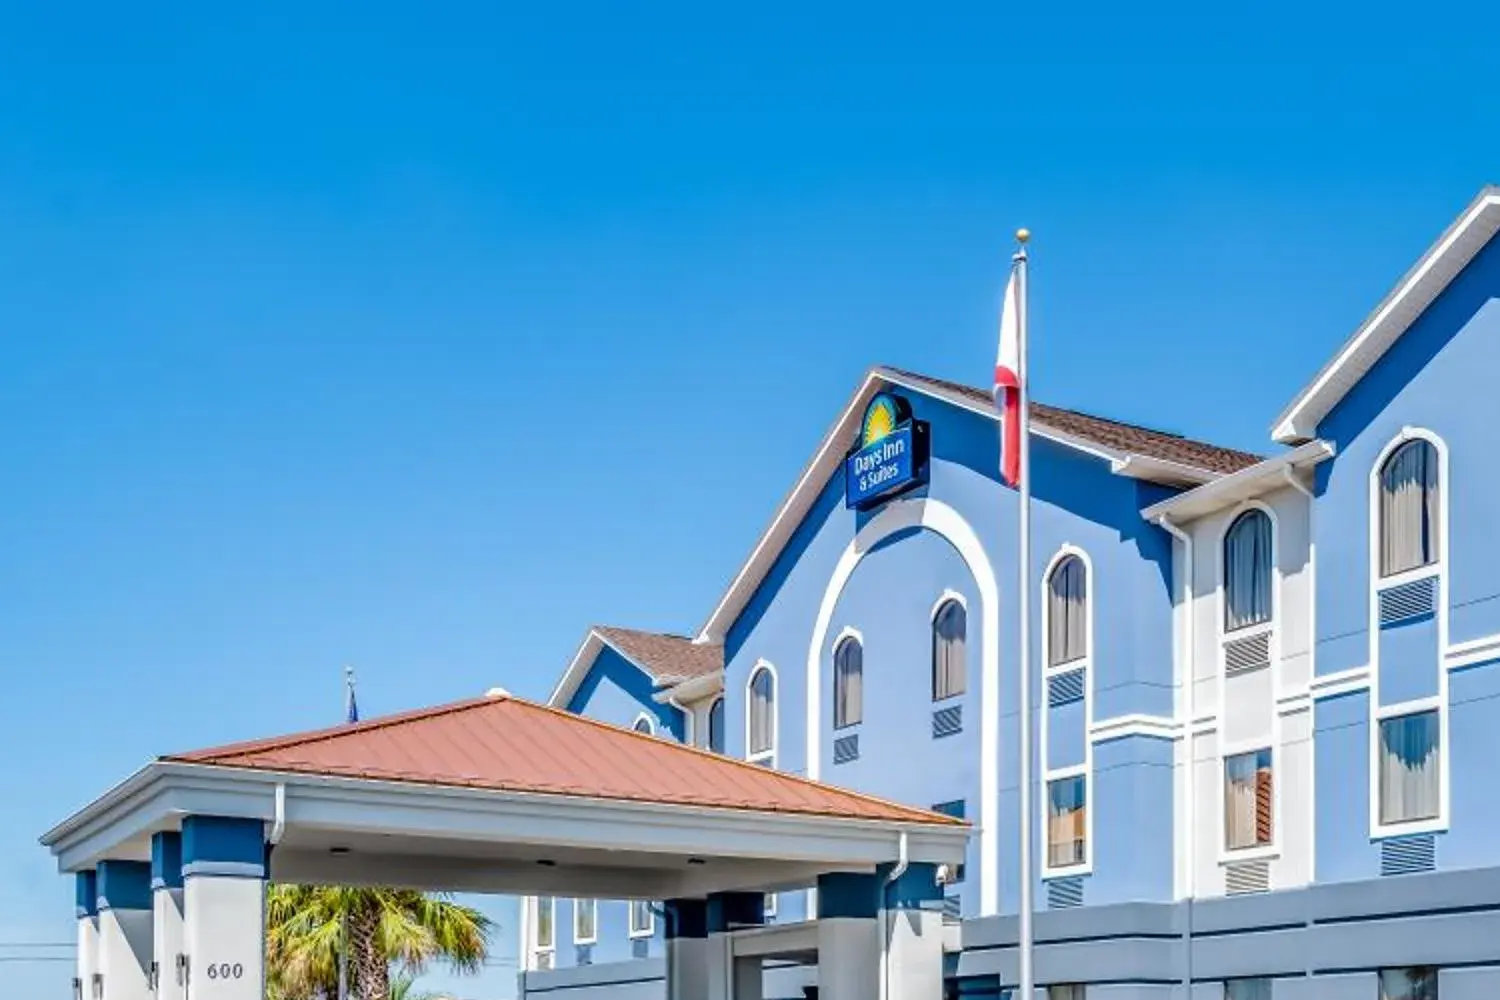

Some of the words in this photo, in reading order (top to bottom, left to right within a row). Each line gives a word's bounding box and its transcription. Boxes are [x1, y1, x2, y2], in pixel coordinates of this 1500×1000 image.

[854, 450, 882, 475] Days
[883, 439, 905, 461] Inn
[859, 475, 867, 492] &
[868, 463, 898, 487] Suites
[207, 963, 243, 979] 600
